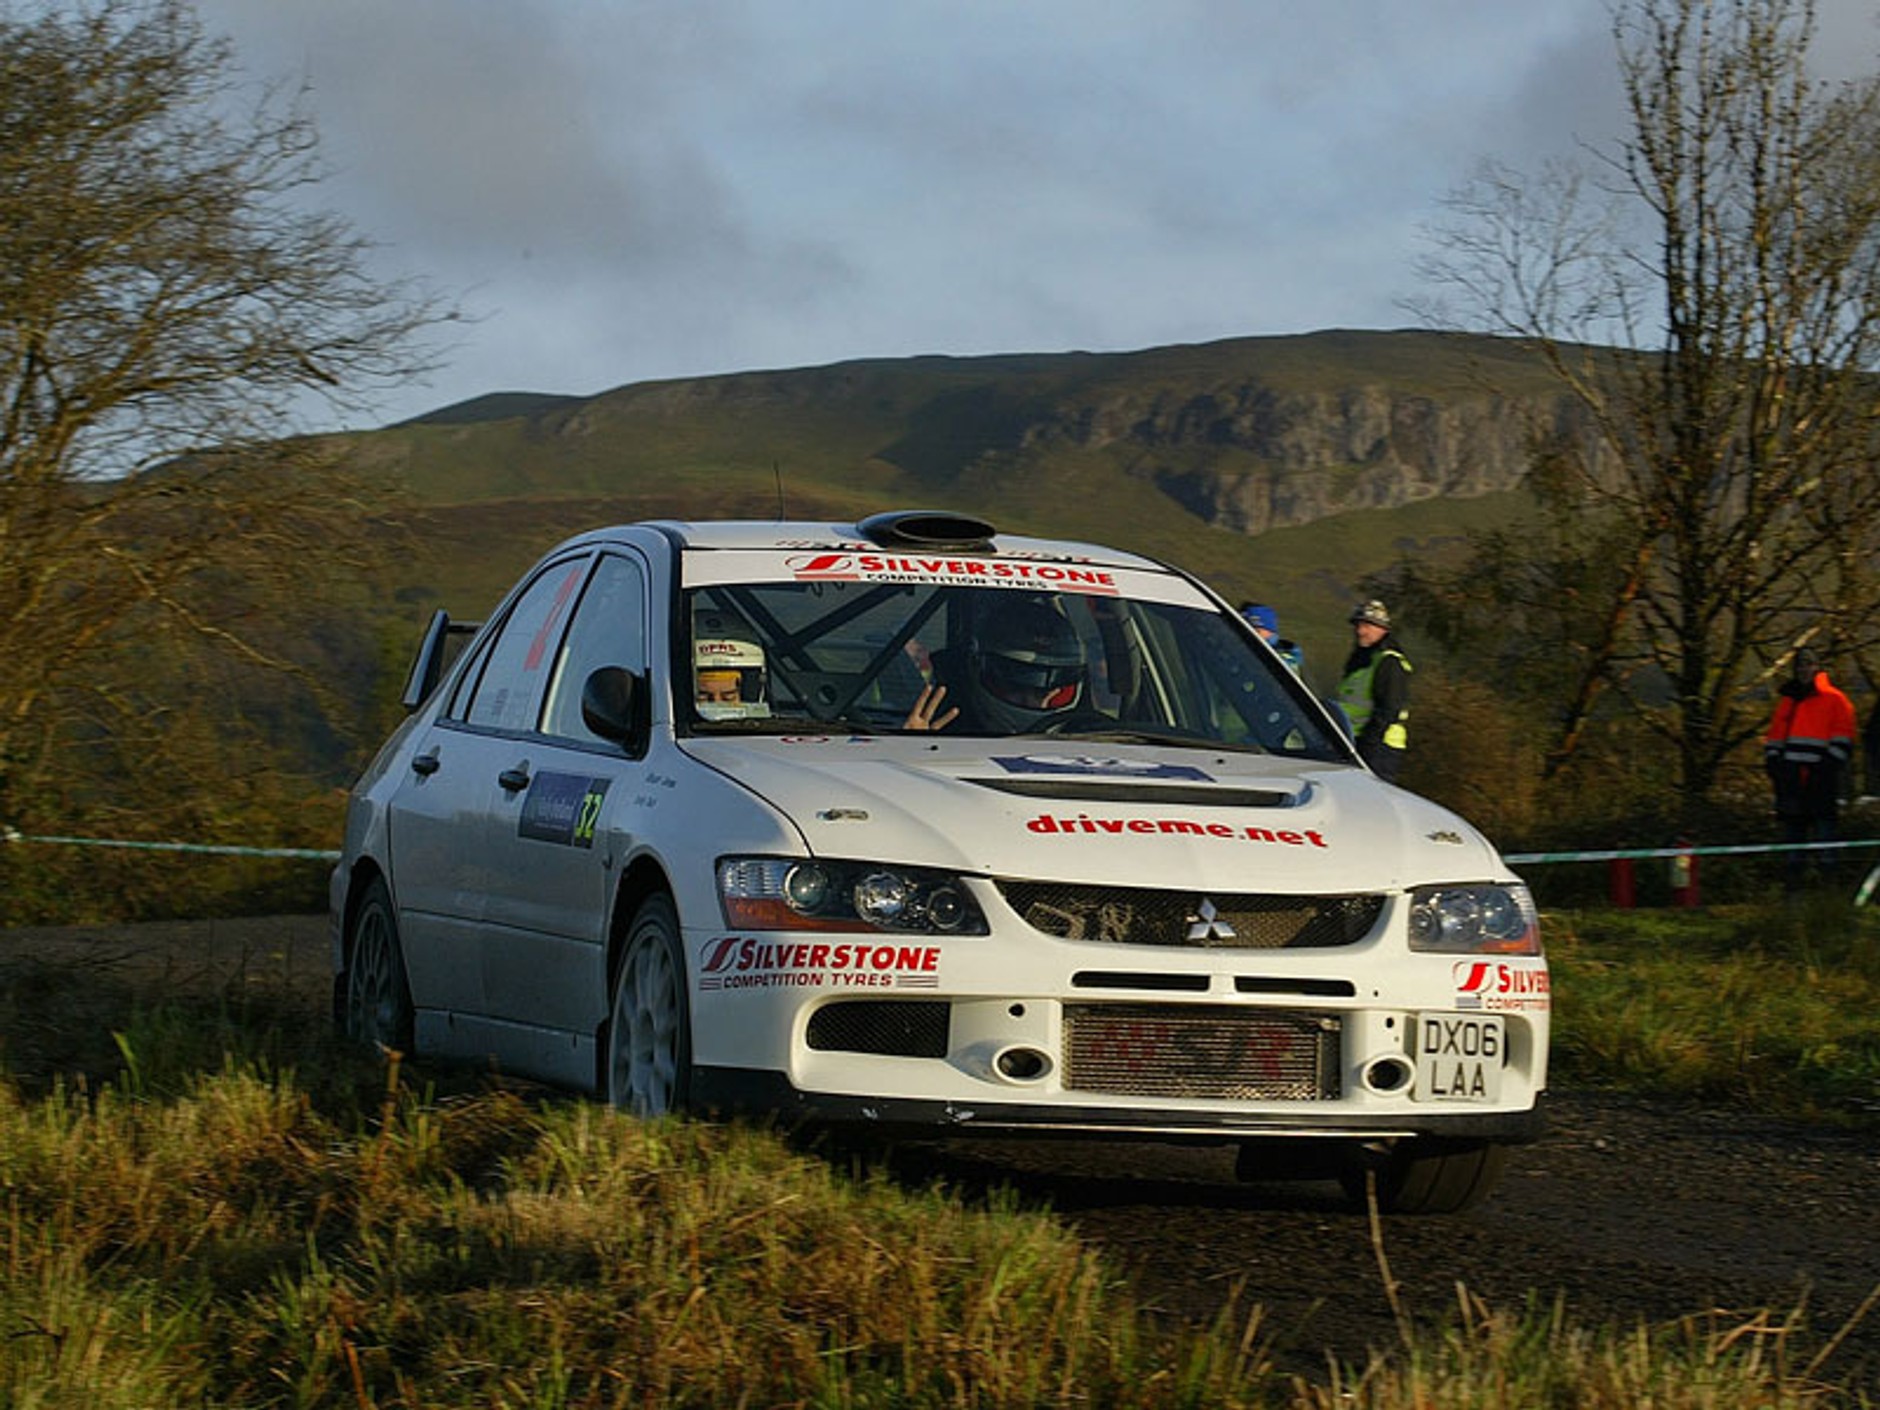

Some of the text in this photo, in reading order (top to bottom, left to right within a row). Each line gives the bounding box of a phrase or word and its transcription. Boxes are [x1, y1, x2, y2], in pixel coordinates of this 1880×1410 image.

[858, 555, 1116, 587] SILVERSTONE
[866, 573, 1049, 589] COMPETITION TYRES
[1027, 814, 1329, 848] driveme.net
[737, 938, 942, 972] SILVERSTONE
[723, 972, 894, 989] COMPETITION TYRES
[1424, 1019, 1499, 1057] DX06
[1431, 1060, 1487, 1097] LAA
